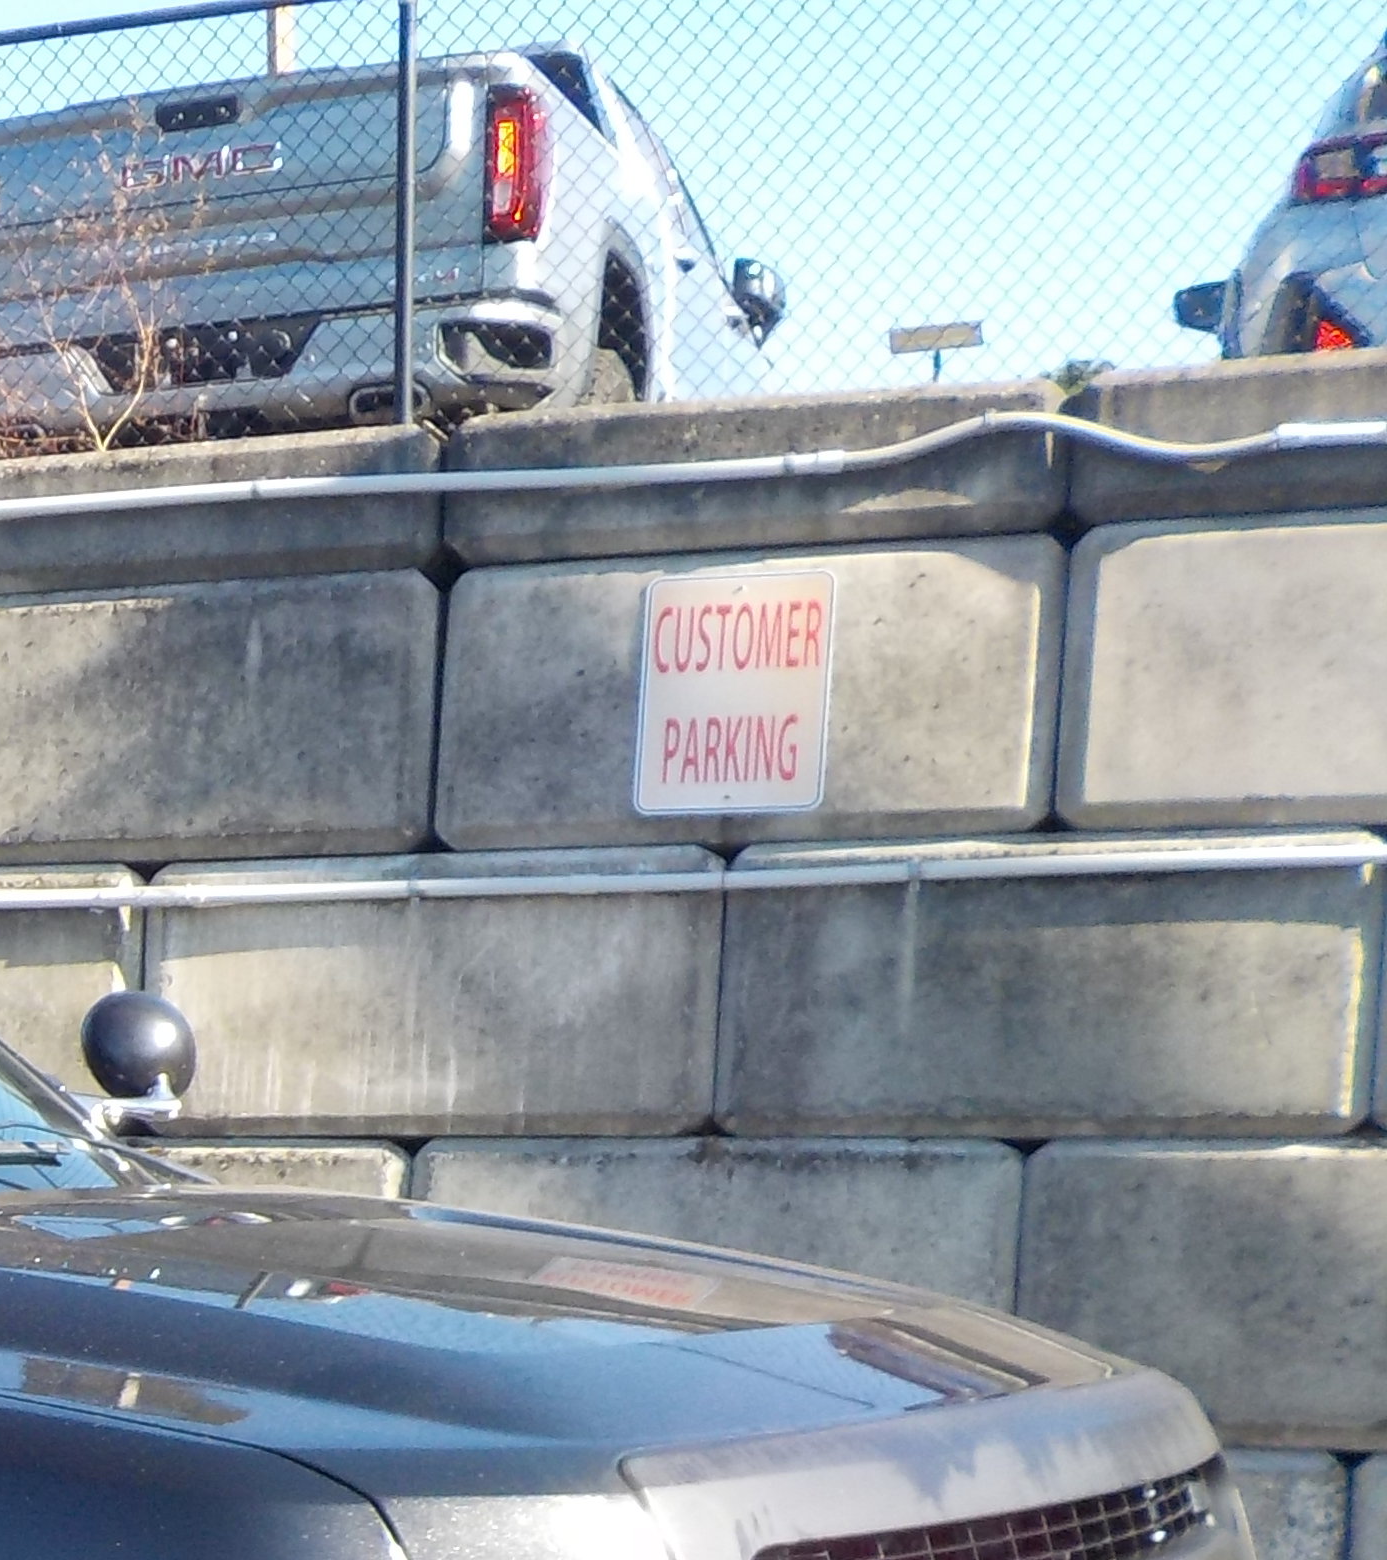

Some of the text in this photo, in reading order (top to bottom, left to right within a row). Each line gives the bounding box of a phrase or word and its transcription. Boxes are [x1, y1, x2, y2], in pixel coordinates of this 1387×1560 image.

[121, 142, 283, 191] GMC
[654, 601, 823, 673] CUSTOMER
[662, 714, 800, 784] PARKING
